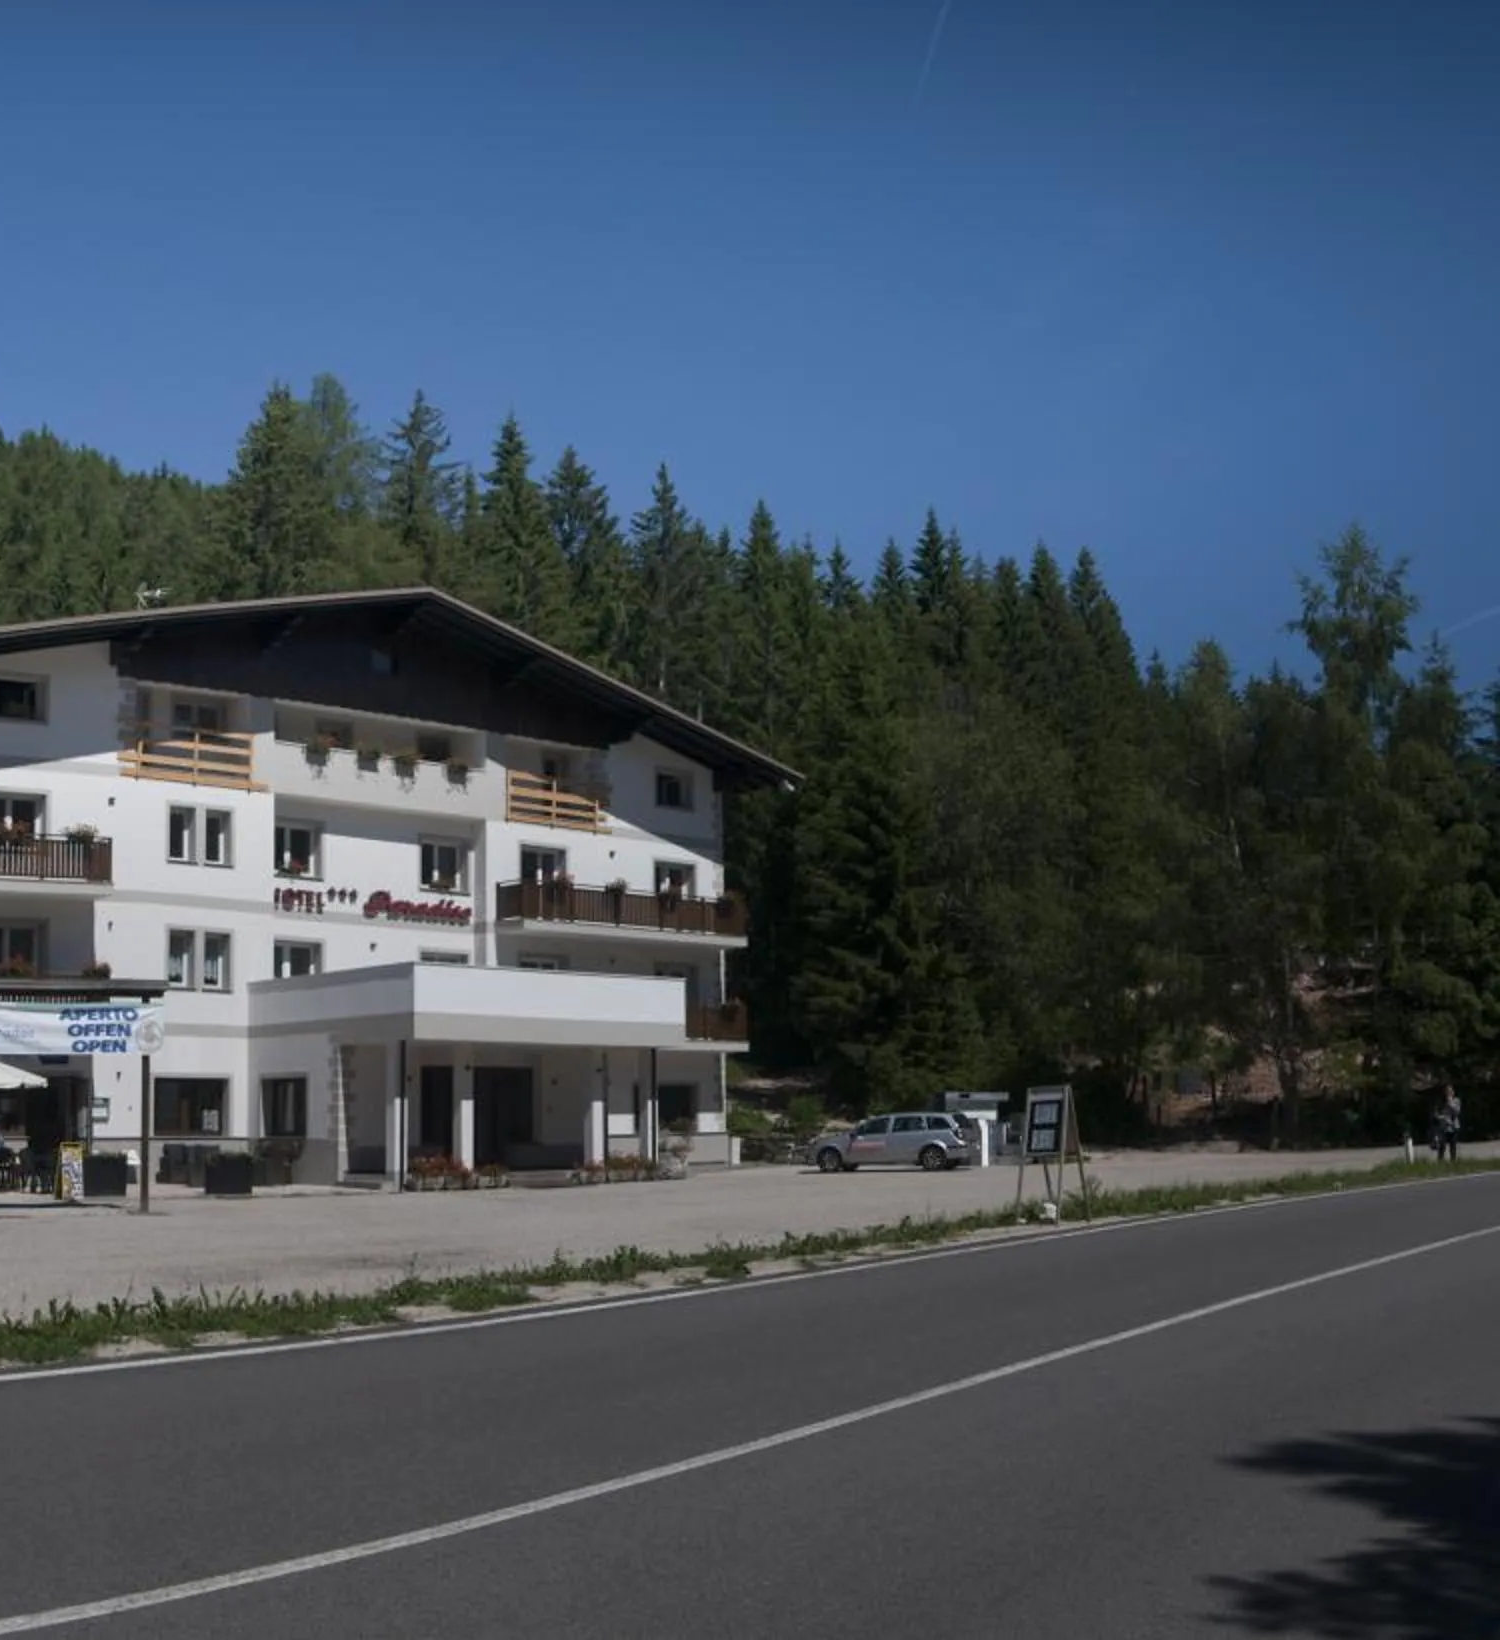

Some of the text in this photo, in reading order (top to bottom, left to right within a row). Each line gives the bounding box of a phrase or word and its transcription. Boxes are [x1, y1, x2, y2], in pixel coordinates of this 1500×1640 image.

[59, 1007, 138, 1021] APERTO
[67, 1023, 132, 1037] OFFEN
[71, 1039, 127, 1053] OPEN
